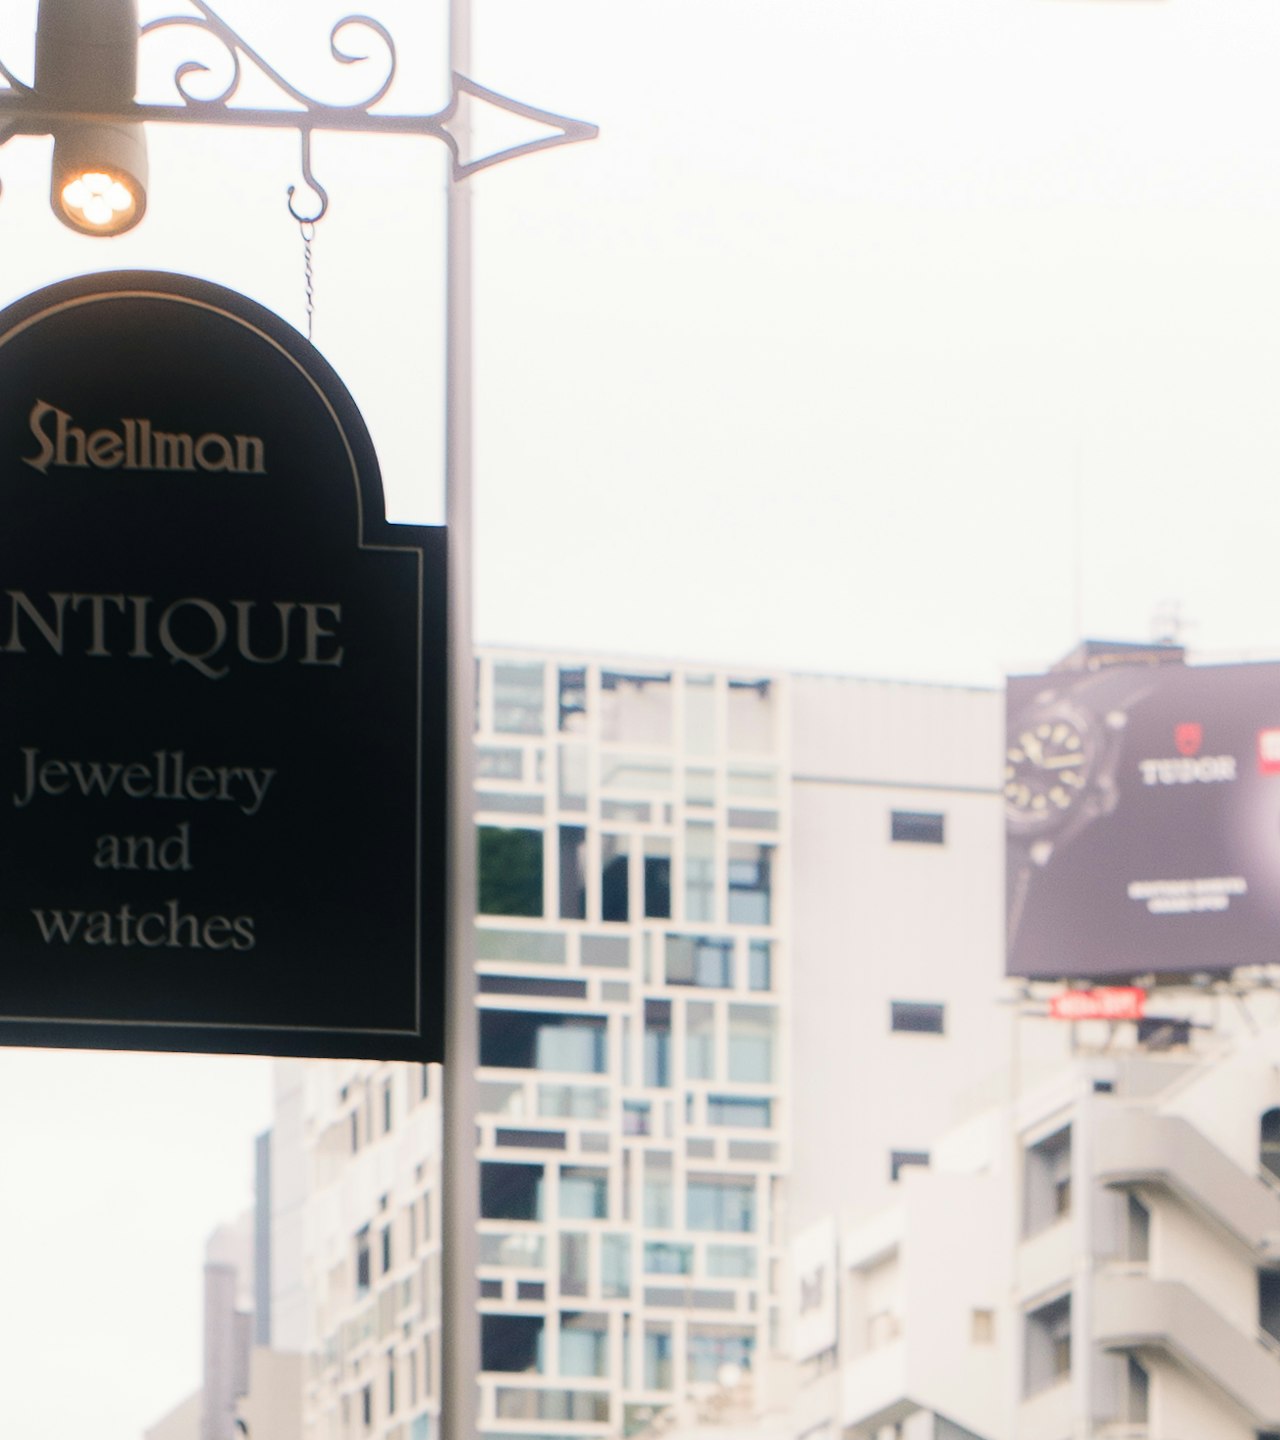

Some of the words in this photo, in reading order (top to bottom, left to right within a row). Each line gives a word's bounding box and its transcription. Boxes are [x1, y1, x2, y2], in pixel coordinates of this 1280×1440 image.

[22, 398, 267, 476] Shellman
[0, 589, 345, 681] NTIQUE
[14, 746, 277, 816] Jewellery
[1138, 754, 1238, 786] TUDOR
[93, 821, 193, 871] and
[32, 899, 257, 951] watches
